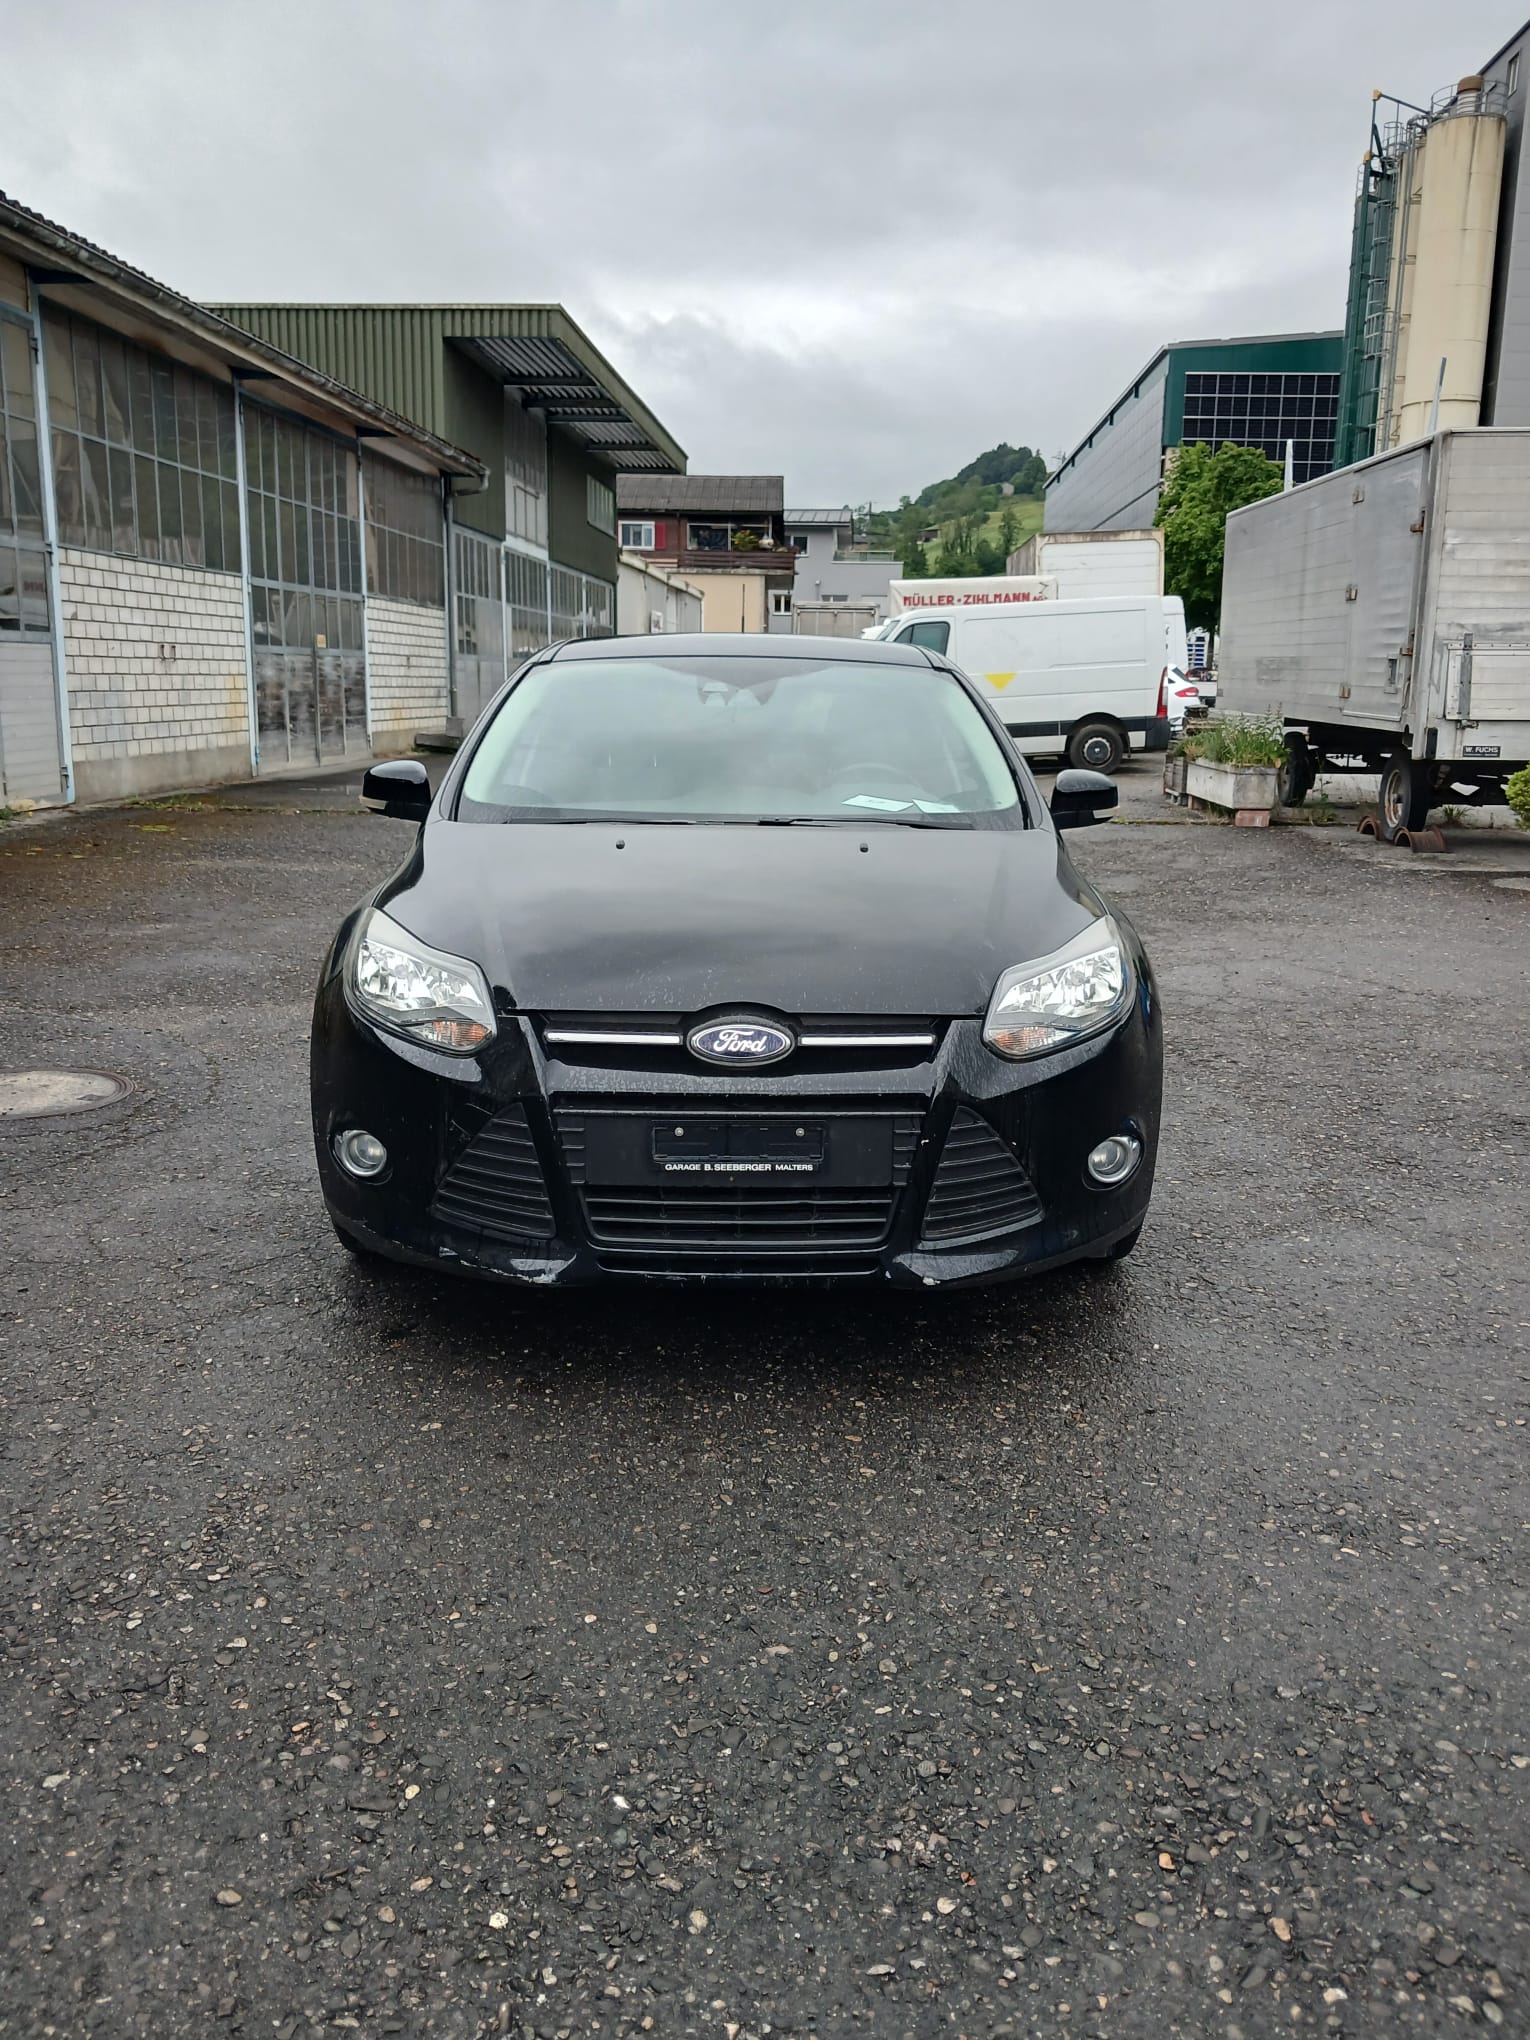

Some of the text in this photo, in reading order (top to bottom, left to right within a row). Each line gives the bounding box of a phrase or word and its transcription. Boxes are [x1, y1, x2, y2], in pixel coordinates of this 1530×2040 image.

[903, 593, 955, 606] MÜLLER
[963, 592, 1031, 605] ZIHLMANN
[713, 1029, 766, 1052] Ford
[664, 1163, 701, 1171] GARAGE
[775, 1163, 813, 1171] MALTERS
